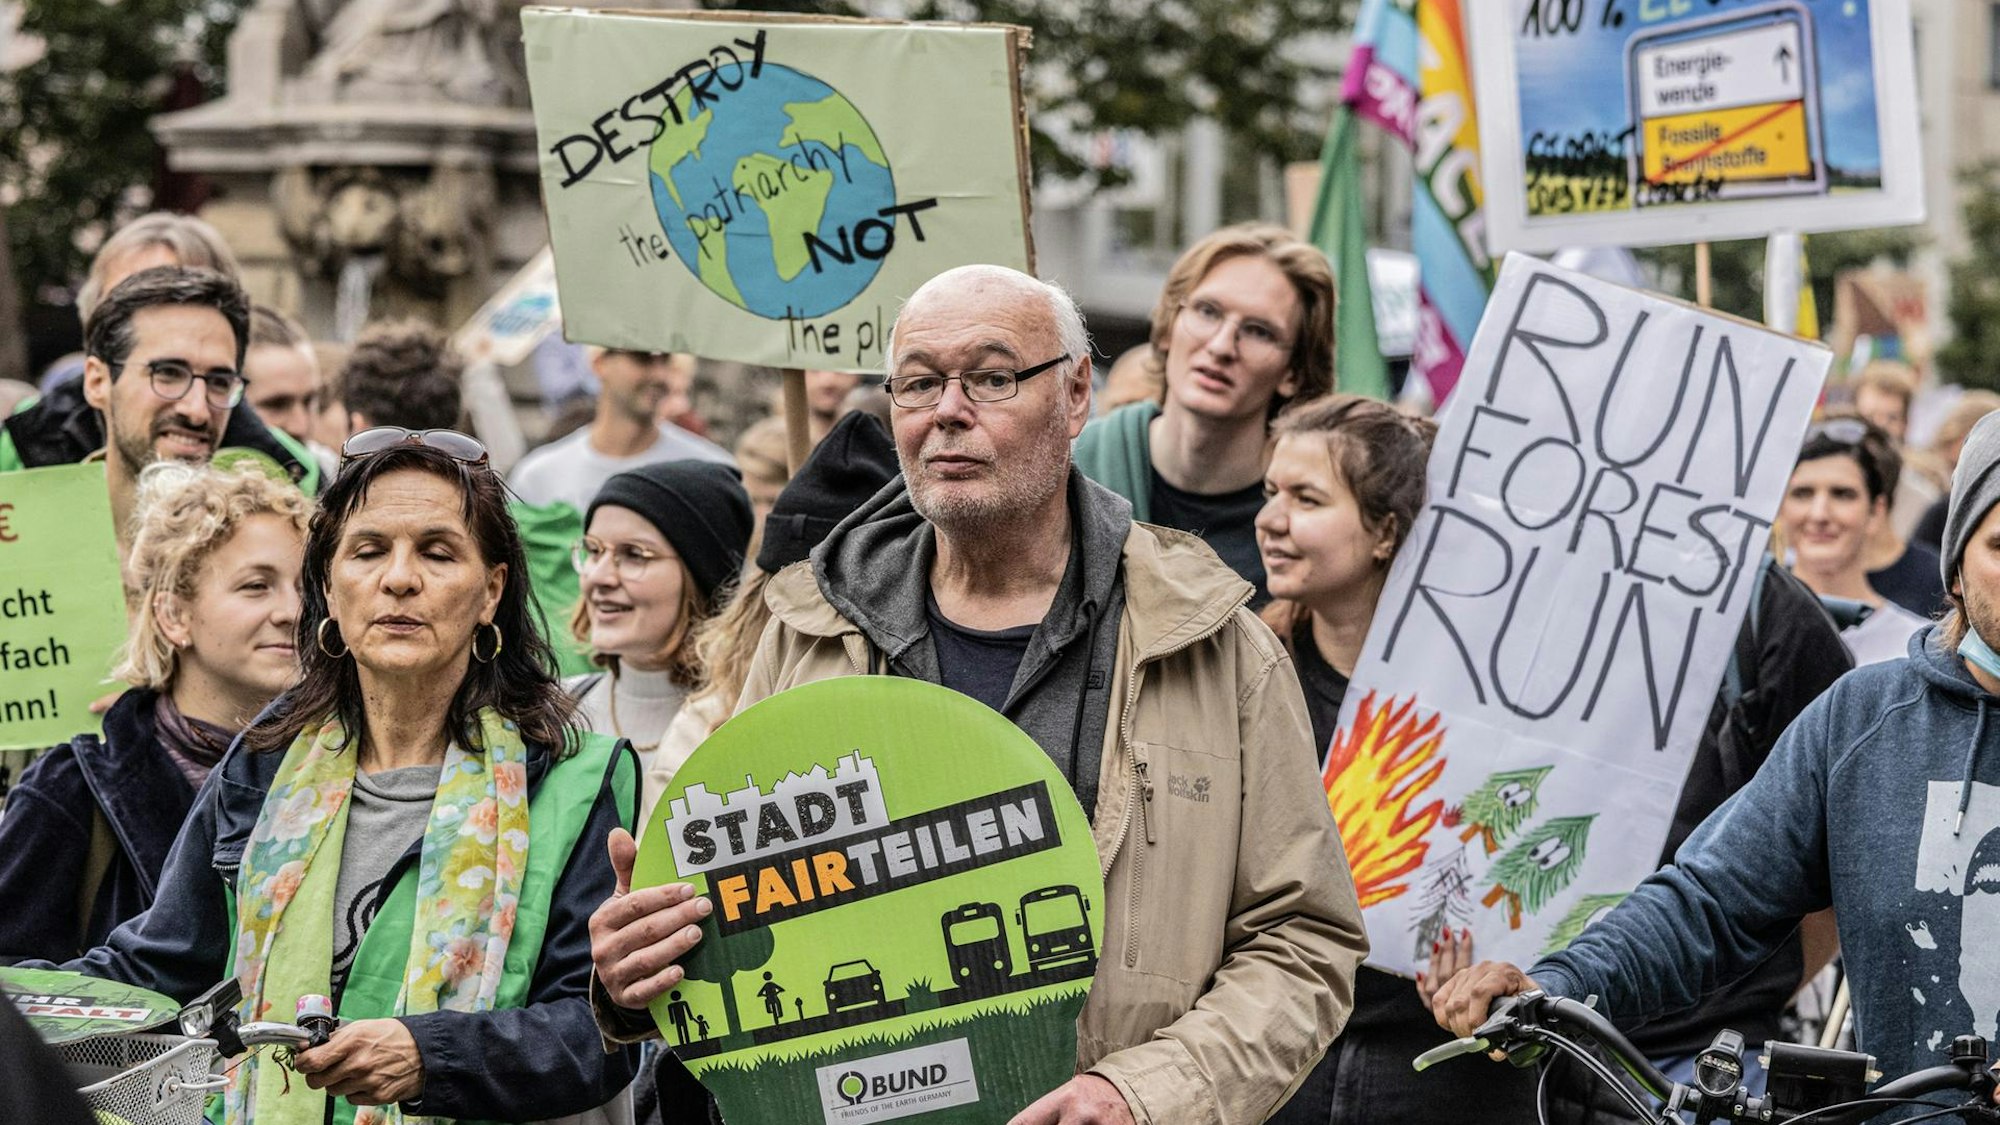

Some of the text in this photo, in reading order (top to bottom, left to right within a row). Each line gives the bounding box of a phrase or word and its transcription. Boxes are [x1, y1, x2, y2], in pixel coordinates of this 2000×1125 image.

[1655, 49, 1732, 79] Energie-
[1656, 83, 1716, 103] wende
[549, 29, 766, 190] DESTROY
[1659, 122, 1722, 145] Fossile
[618, 132, 852, 267] the patriarchy
[802, 198, 938, 274] NOT
[785, 305, 894, 366] the pl
[1484, 271, 1797, 499] RUN
[1447, 406, 1772, 615] FOREST
[1382, 505, 1703, 752] RUN
[0, 689, 59, 724] nn!
[681, 779, 870, 866] STADT
[716, 797, 1045, 922] FAIRTEILEN
[26, 1005, 142, 1018] FALT
[841, 1107, 869, 1119] FRIENDS
[881, 1102, 894, 1110] THE
[895, 1097, 916, 1107] EARTH
[918, 1091, 952, 1103] GERMANY
[871, 1063, 948, 1098] BUND
